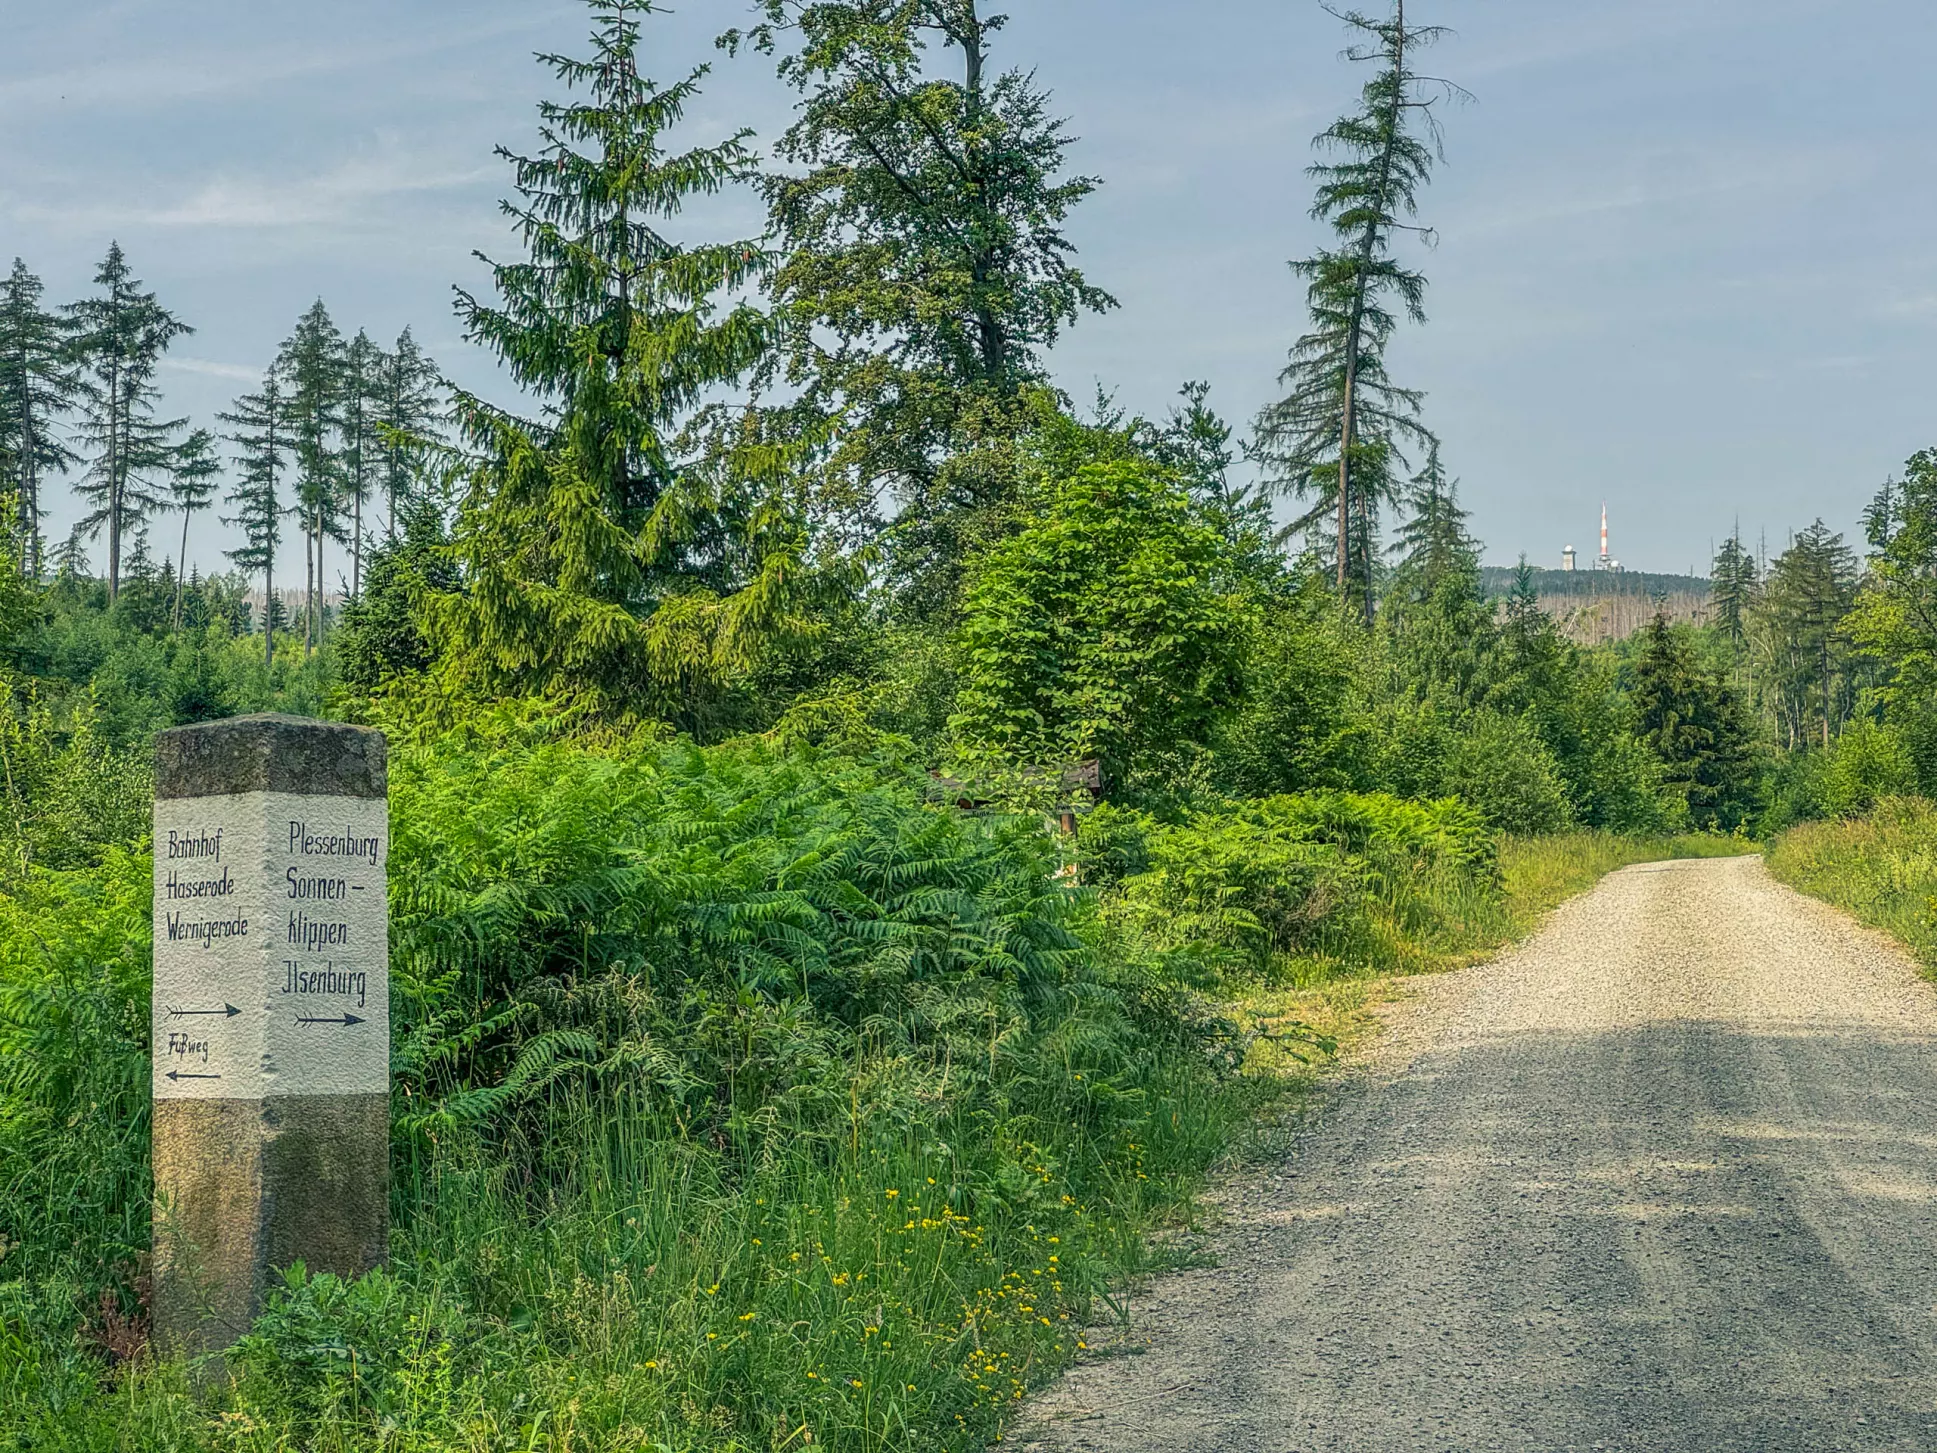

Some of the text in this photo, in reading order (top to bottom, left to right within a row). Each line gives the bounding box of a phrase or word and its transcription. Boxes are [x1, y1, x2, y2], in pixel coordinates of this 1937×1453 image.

[168, 827, 223, 863] Bahnhof
[289, 821, 379, 866] Plessenburg
[166, 866, 234, 899] Hasserode
[166, 906, 248, 949] Wernigerode
[168, 1033, 208, 1063] Fußweg
